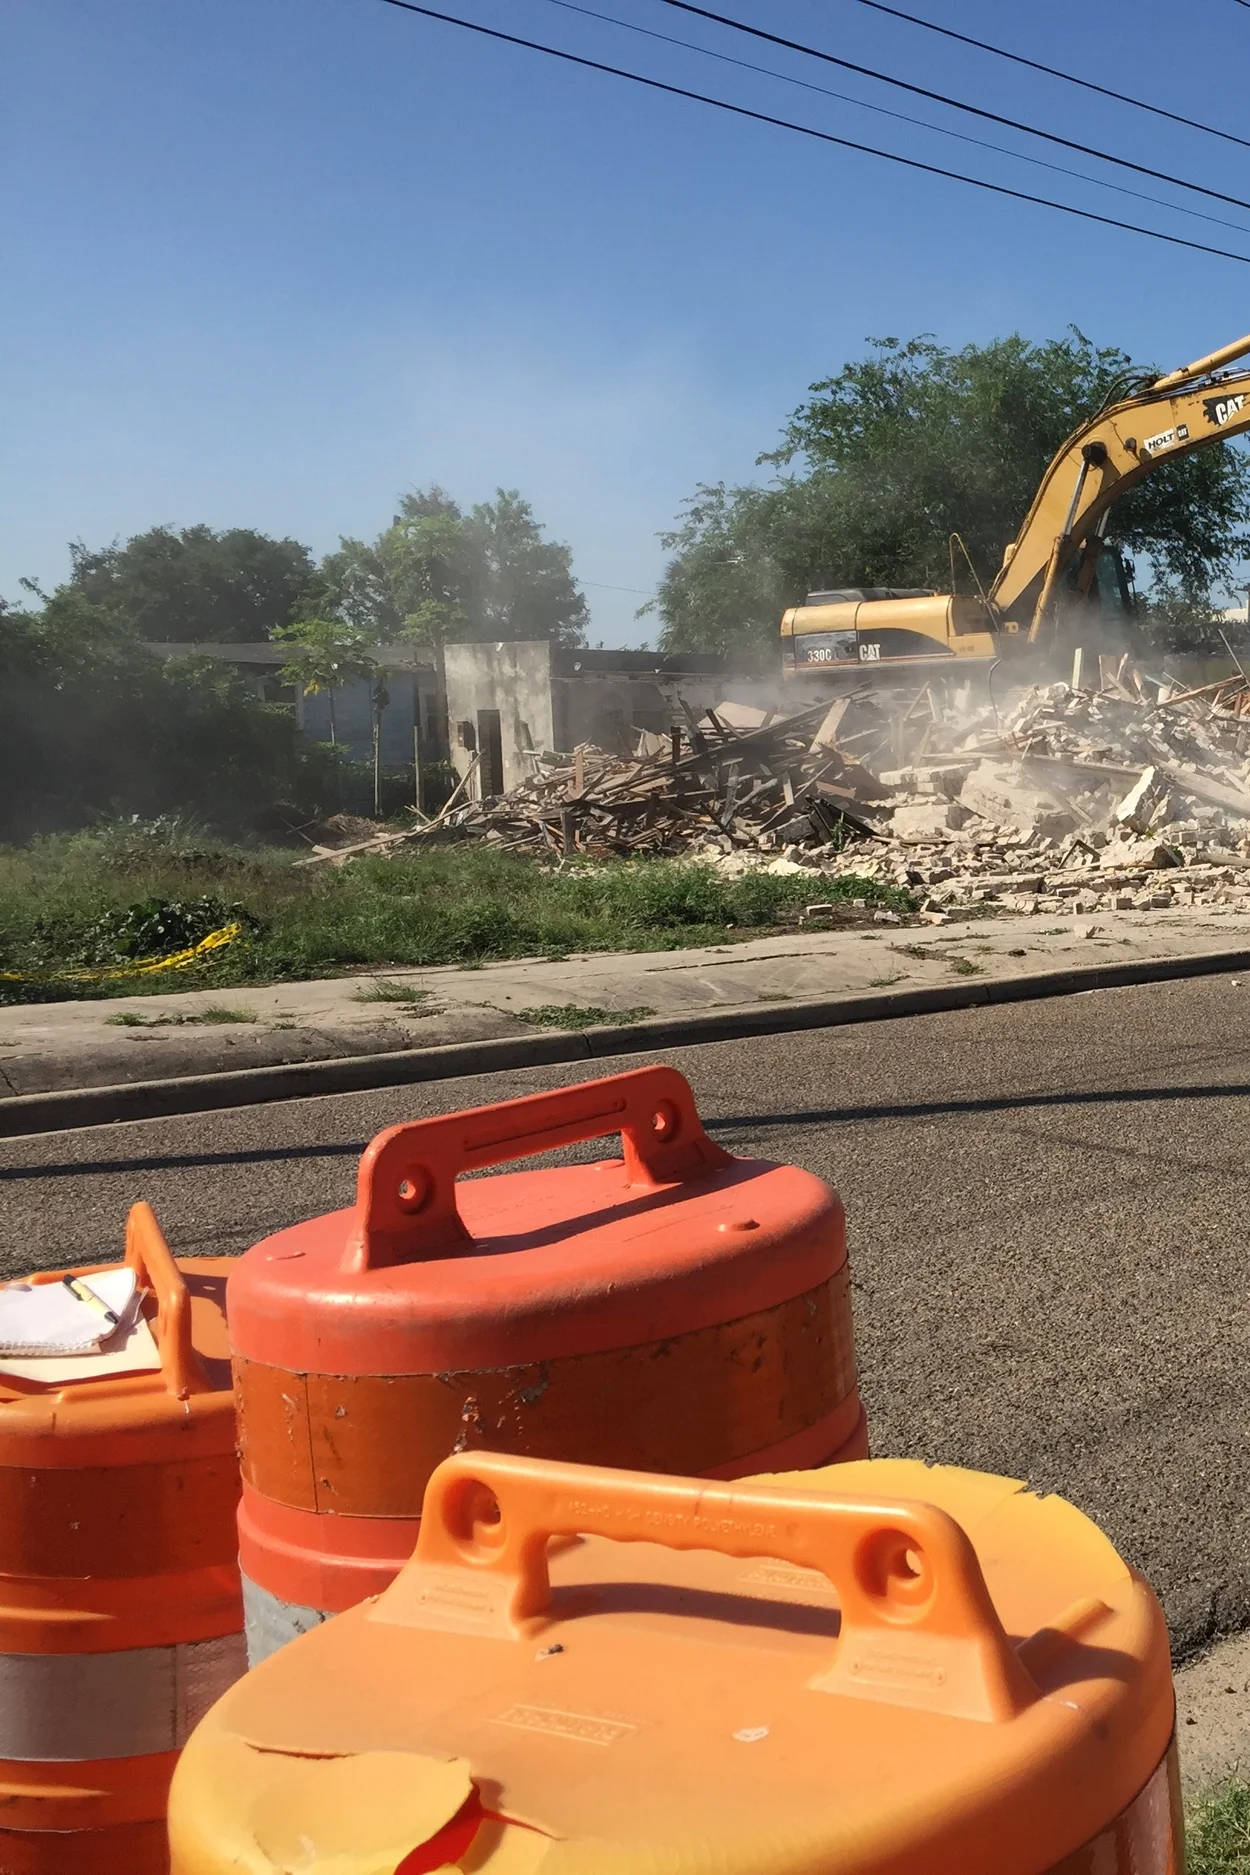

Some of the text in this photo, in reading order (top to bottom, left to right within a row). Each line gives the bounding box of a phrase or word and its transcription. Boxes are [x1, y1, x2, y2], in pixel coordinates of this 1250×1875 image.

[1215, 395, 1244, 425] CAT
[1148, 432, 1174, 450] HOLT
[807, 648, 832, 663] 330C
[859, 643, 881, 662] CAT
